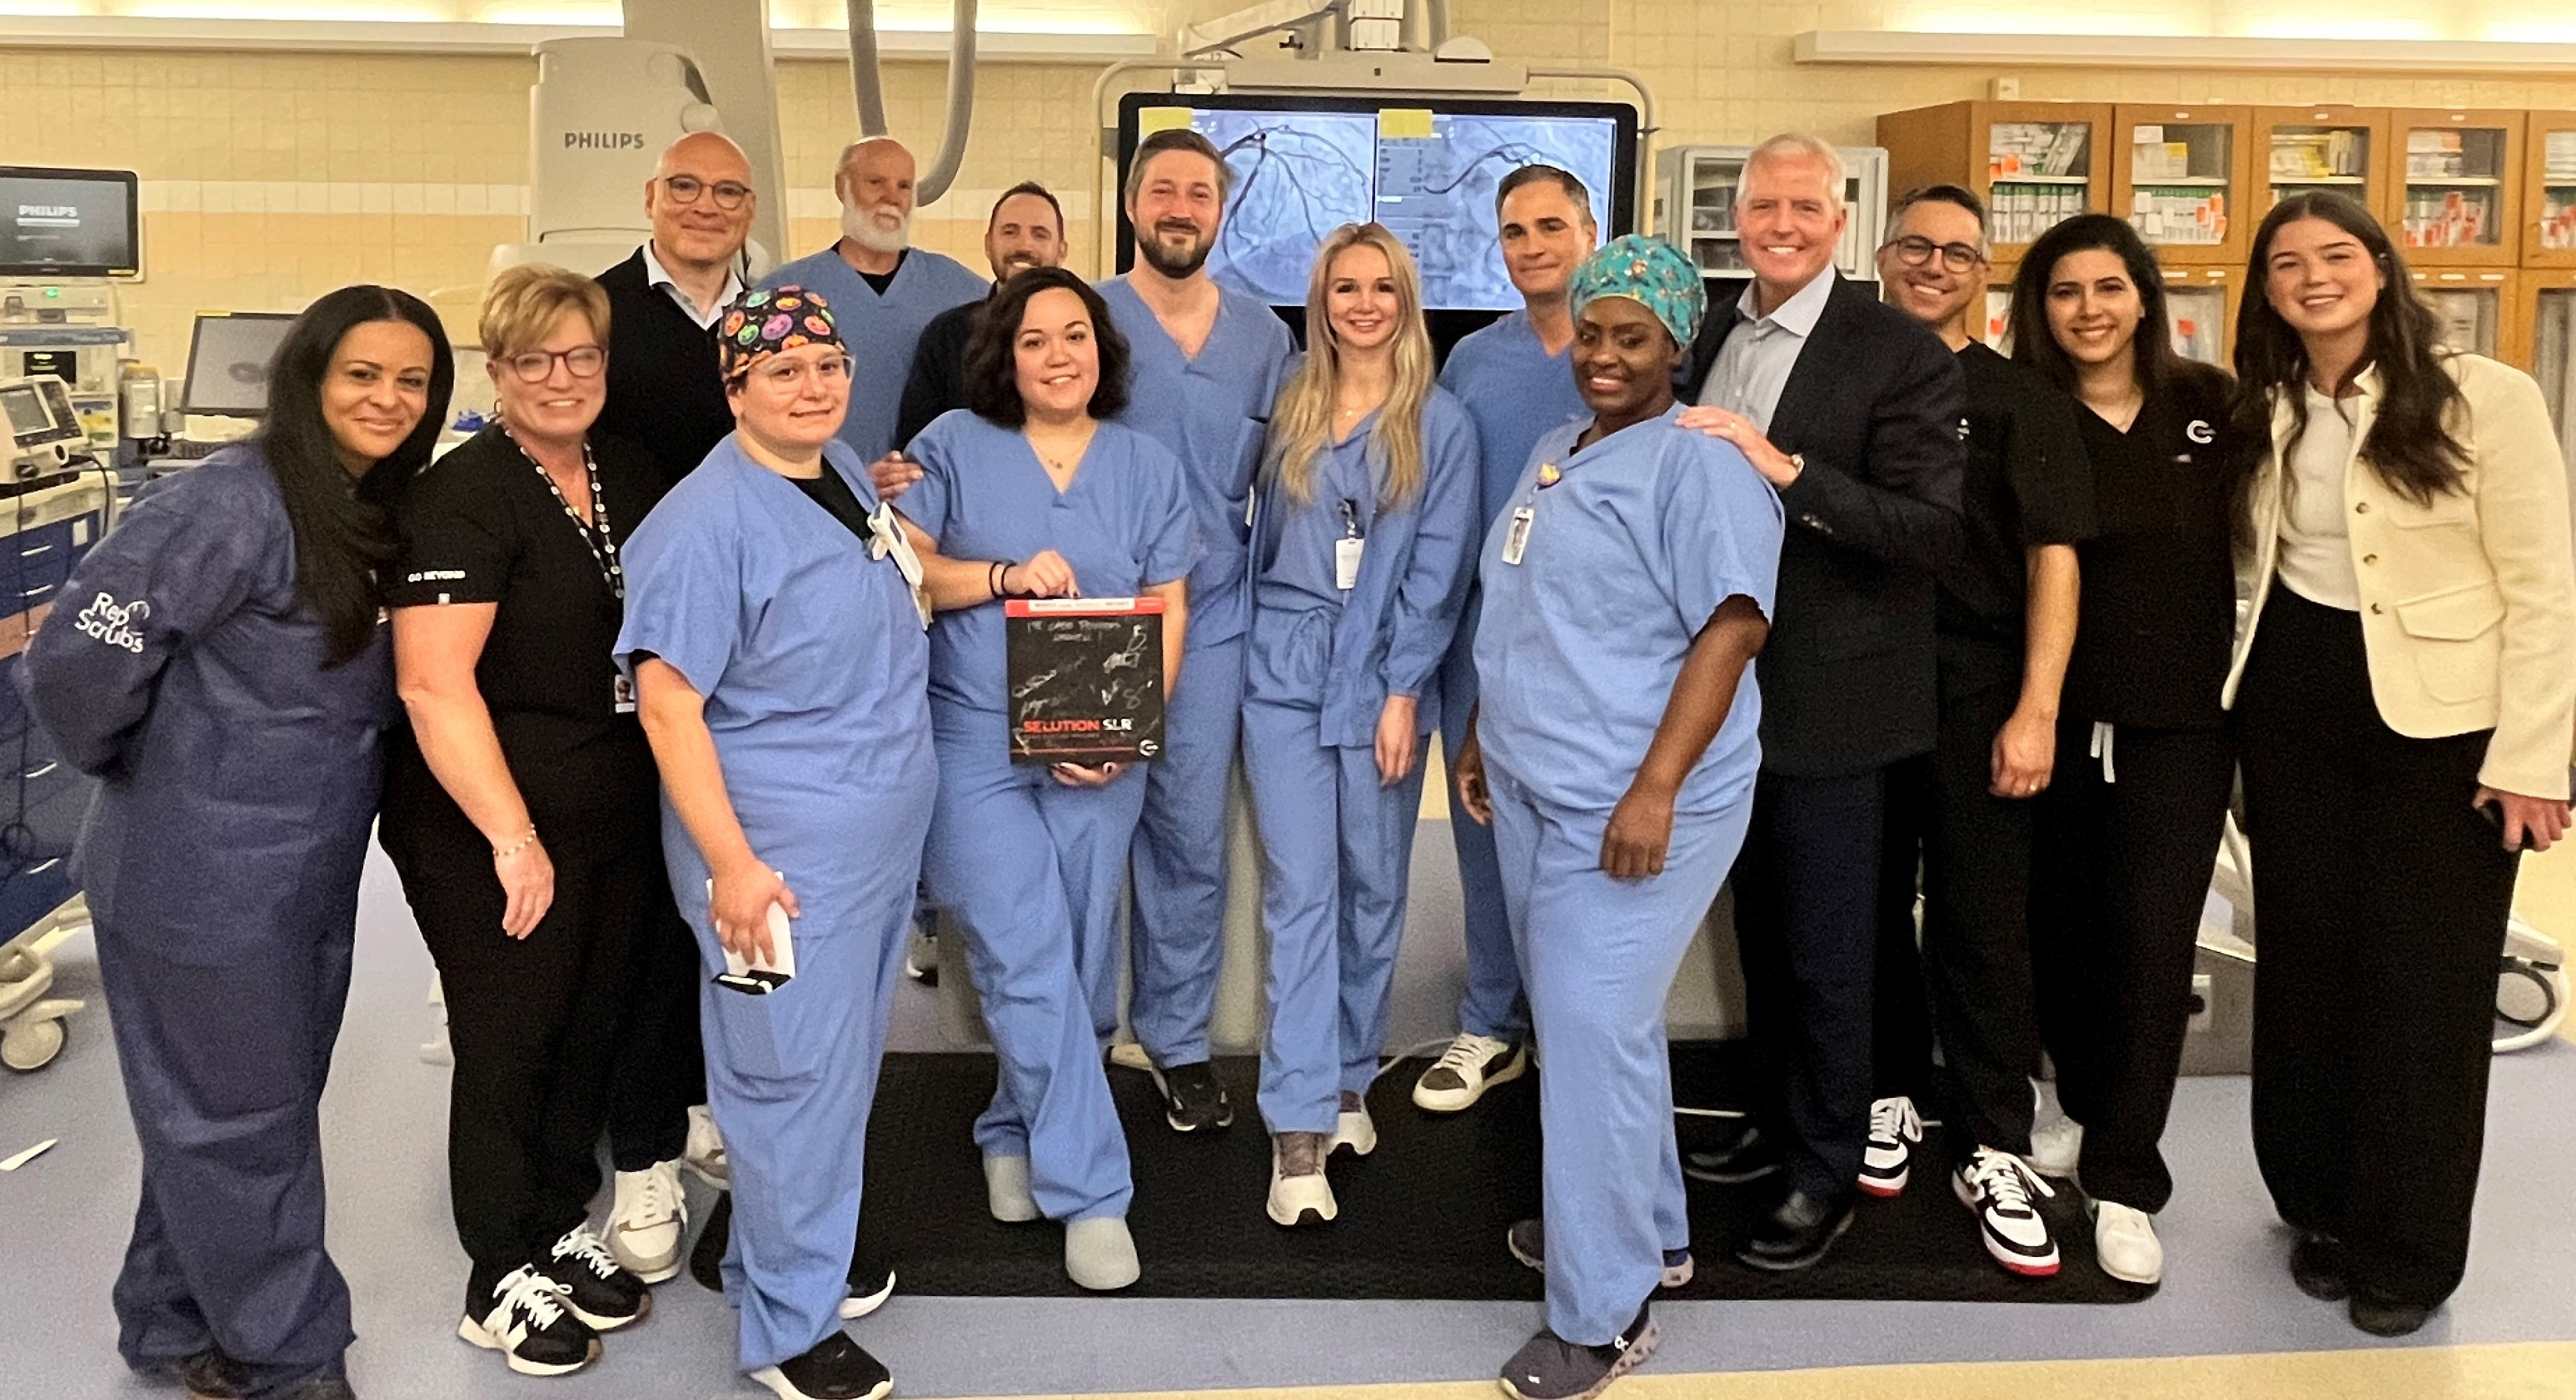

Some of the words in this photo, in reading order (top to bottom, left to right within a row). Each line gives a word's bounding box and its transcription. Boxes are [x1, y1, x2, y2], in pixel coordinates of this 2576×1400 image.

[565, 132, 644, 149] PHILIPS
[18, 205, 78, 218] PHILIPS
[91, 591, 130, 629] Rep
[74, 609, 144, 653] Scrubs
[1023, 720, 1100, 732] SELUTION
[1103, 718, 1132, 731] SLR
